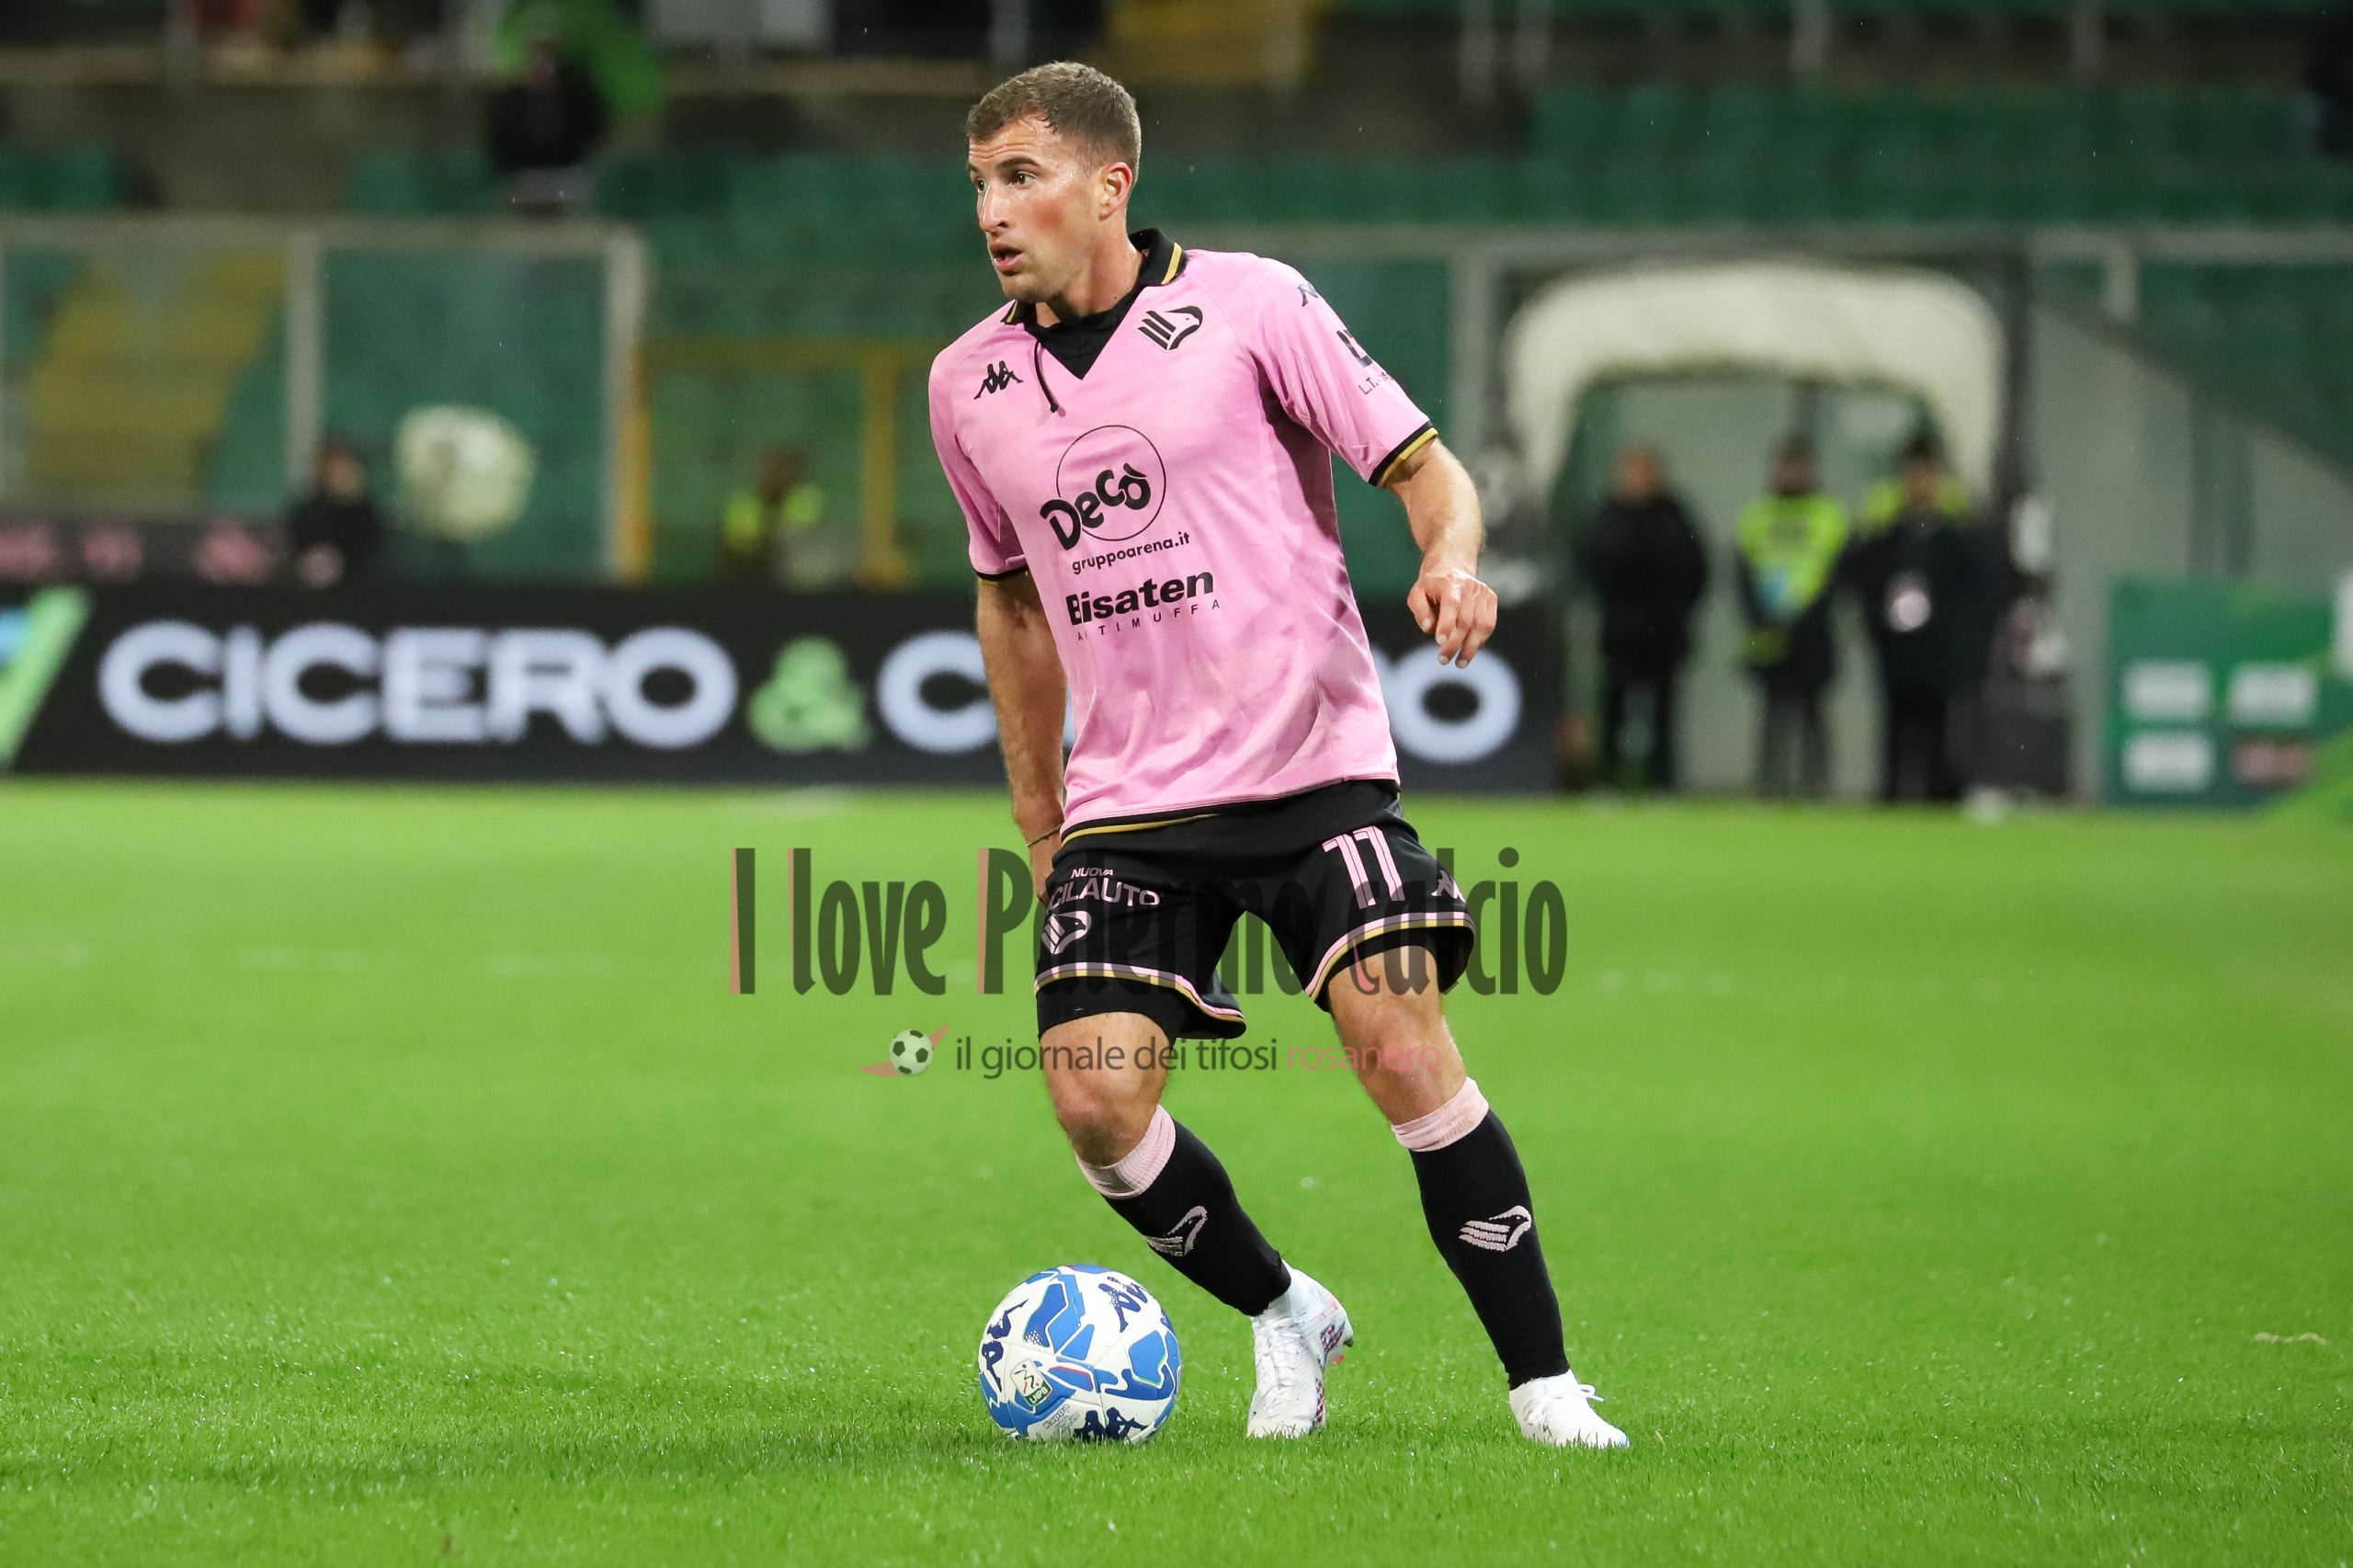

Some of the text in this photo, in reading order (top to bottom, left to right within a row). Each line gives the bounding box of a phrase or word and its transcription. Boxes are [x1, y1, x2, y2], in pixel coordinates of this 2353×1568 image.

[1072, 531, 1190, 575] gruppoarena.it
[1065, 571, 1214, 626] Bisaten
[1076, 599, 1221, 642] ATIMUFFA
[98, 620, 738, 750] CICERO
[1071, 867, 1114, 879] NUOVA
[1322, 825, 1406, 910] 11
[1046, 877, 1161, 912] CILAUTO
[1029, 1386, 1049, 1404] LNPB
